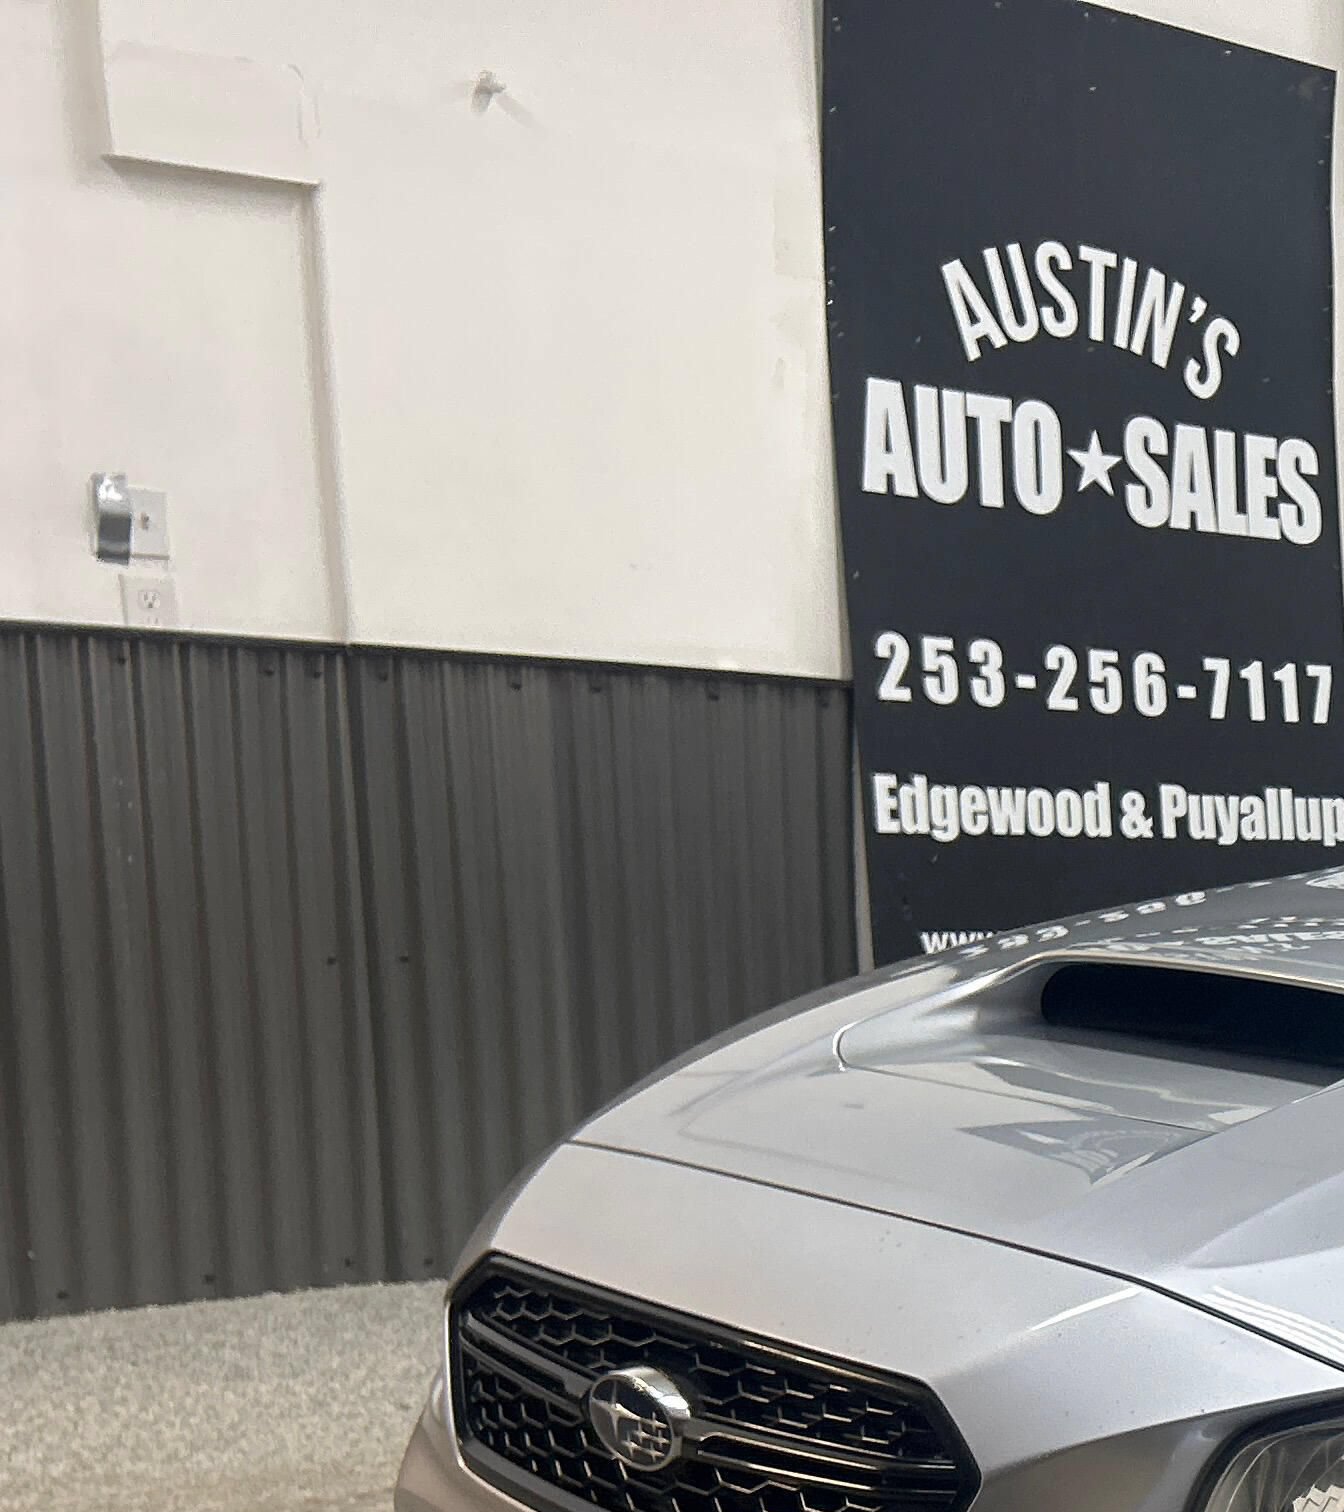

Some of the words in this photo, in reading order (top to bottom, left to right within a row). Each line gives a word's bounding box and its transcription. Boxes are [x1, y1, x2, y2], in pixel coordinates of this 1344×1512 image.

[942, 240, 1240, 400] AUSTIN'S
[862, 376, 1064, 515] AUTO
[1124, 416, 1322, 545] SALES
[874, 631, 1333, 724] 253-256-7117
[872, 772, 1113, 843] Edgewood
[1120, 790, 1154, 839] &
